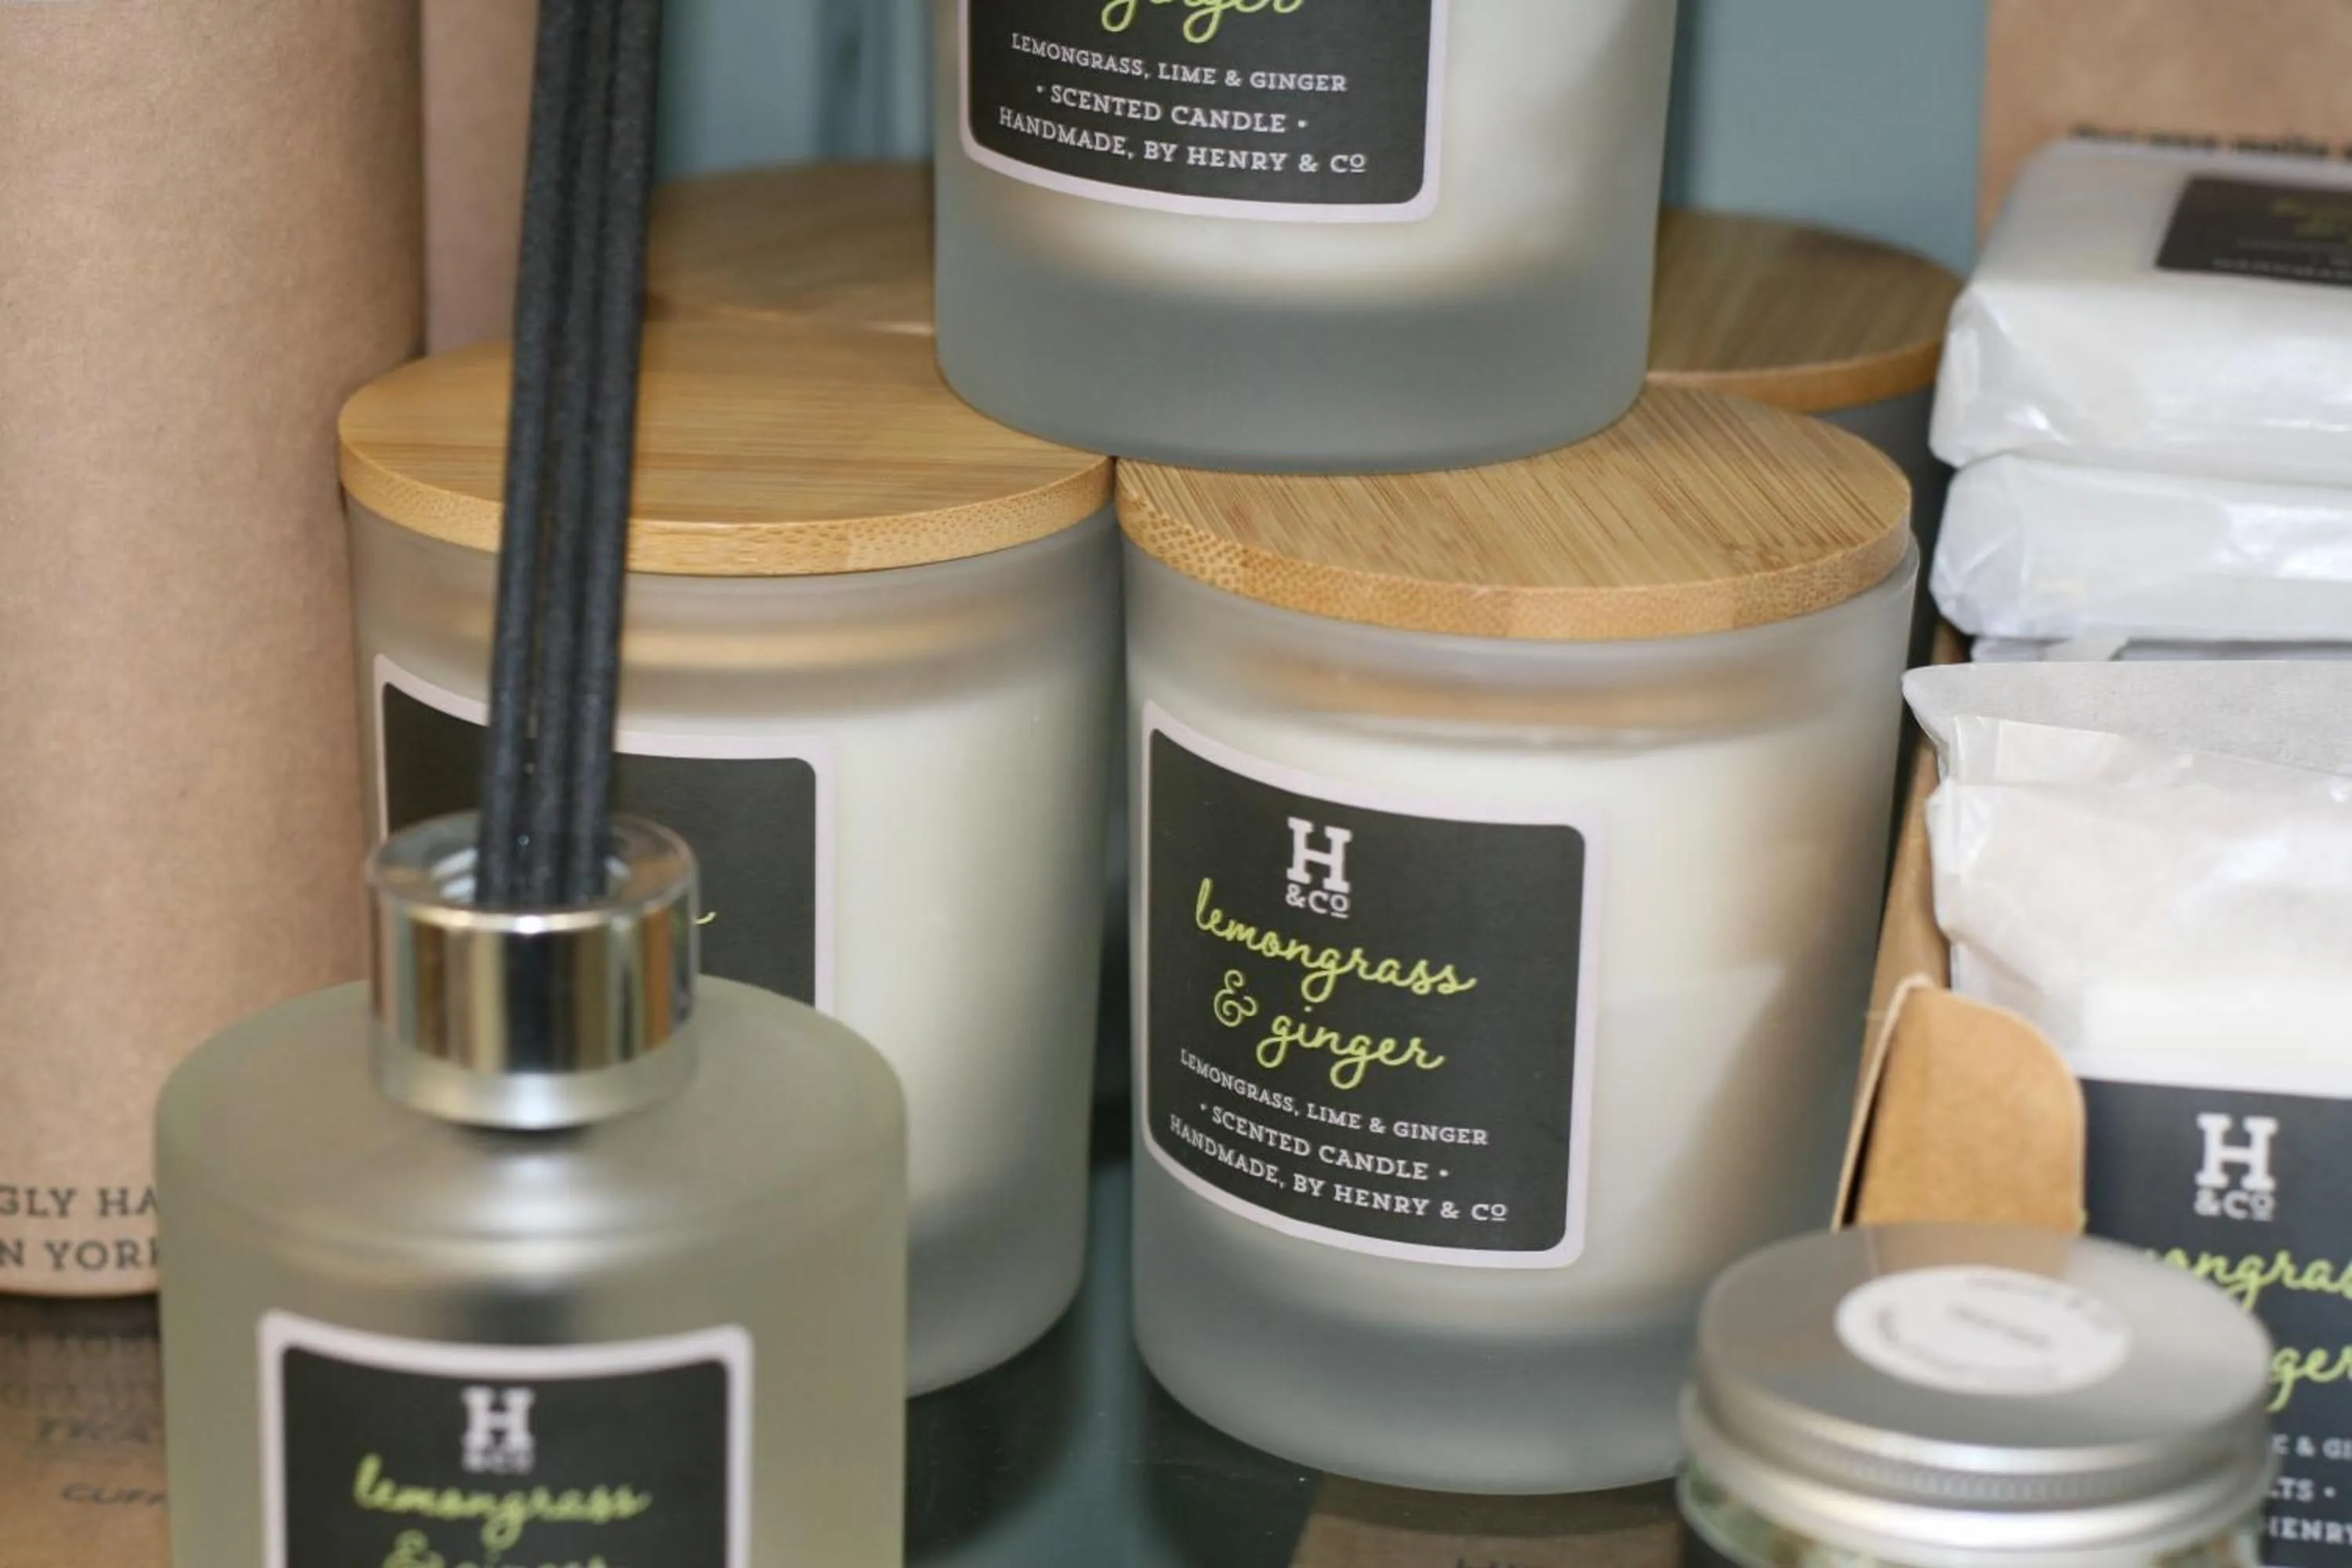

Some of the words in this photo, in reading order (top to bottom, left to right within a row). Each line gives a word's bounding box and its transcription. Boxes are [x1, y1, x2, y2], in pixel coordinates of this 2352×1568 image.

[1011, 33, 1150, 79] LEMONGRASS,
[1158, 62, 1218, 85] LIME
[1224, 69, 1243, 87] &
[1250, 71, 1348, 93] GINGER
[999, 107, 1134, 159] HANDMADE,
[1143, 140, 1178, 162] BY
[1186, 145, 1289, 172] HENRY
[1298, 153, 1319, 173] &
[1051, 85, 1163, 122] SCENTED
[1171, 105, 1287, 133] CANDLE
[1286, 816, 1353, 895] H
[1196, 877, 1478, 1004] lemongrass
[1214, 969, 1258, 1027] &
[1256, 1005, 1446, 1090] ginger
[1180, 1048, 1299, 1116] LEMONGRASS,
[1306, 1103, 1362, 1130] LIME
[1368, 1116, 1386, 1134] &
[1392, 1120, 1489, 1145] GINGER
[1171, 1114, 1284, 1189] HANDMADE,
[1293, 1173, 1326, 1197] BY
[1334, 1183, 1430, 1216] HENRY
[1439, 1200, 1461, 1220] &
[1212, 1105, 1311, 1156] SCENTED
[1318, 1145, 1429, 1181] CANDLE
[2195, 1112, 2278, 1189] H
[461, 1385, 536, 1452] H
